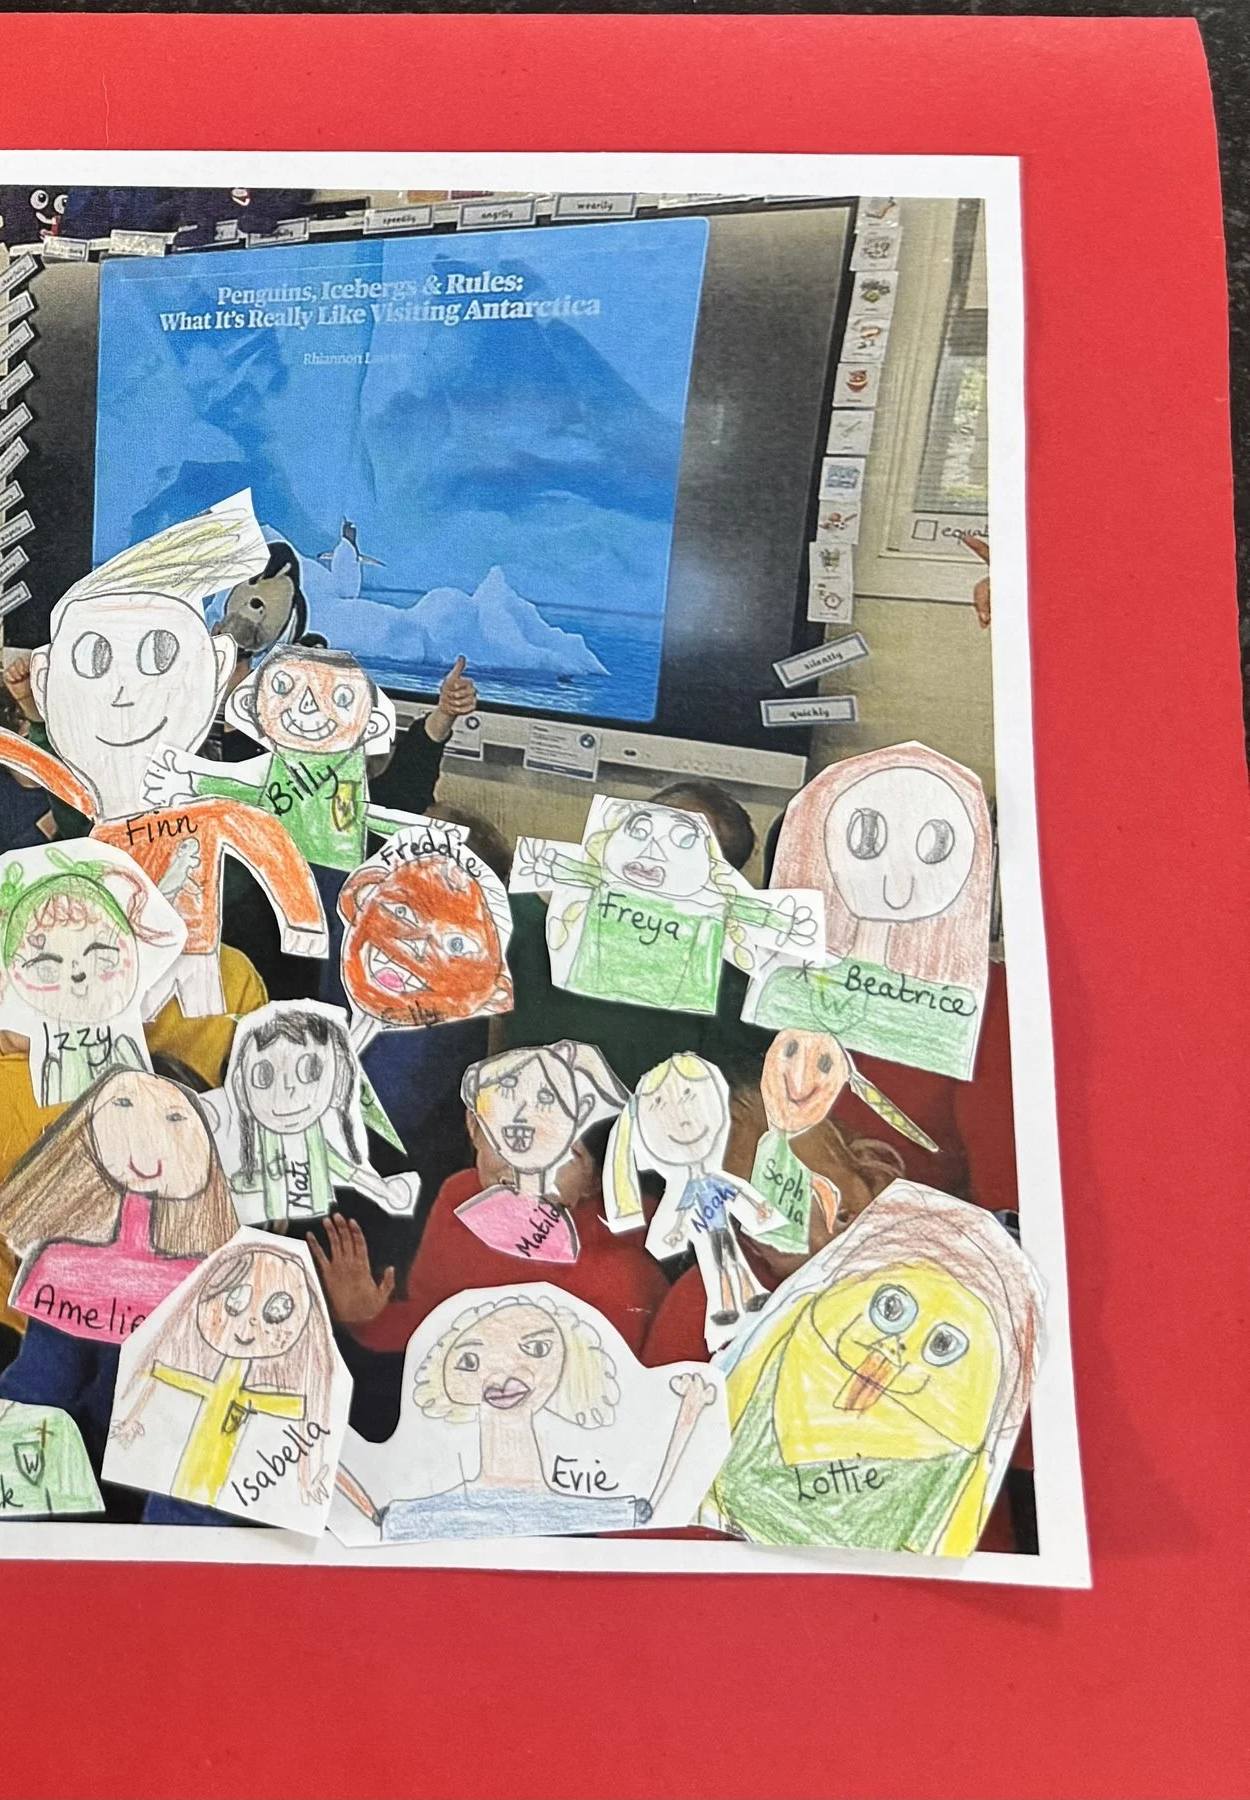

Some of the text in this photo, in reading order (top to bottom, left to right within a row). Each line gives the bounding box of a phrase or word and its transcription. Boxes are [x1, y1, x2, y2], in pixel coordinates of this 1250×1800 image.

[160, 311, 211, 331] What
[248, 306, 312, 330] Really
[317, 304, 366, 325] Like
[370, 301, 462, 326] Visiting
[463, 295, 600, 321] Antarctica
[217, 271, 524, 307] Penguins, Icebergs & Rules:
[303, 352, 362, 366] Rhiannon
[789, 706, 830, 719] quickly
[265, 760, 340, 817] Billy
[126, 809, 199, 846] Finn
[379, 826, 482, 878] Freddie
[597, 891, 681, 944] Freya
[843, 963, 978, 1018] Beatrice
[42, 1021, 114, 1067] Izzy
[690, 1184, 737, 1235] Noah
[230, 1420, 331, 1507] Isabella
[551, 1454, 620, 1493] Evie
[793, 1452, 885, 1503] Lottie
